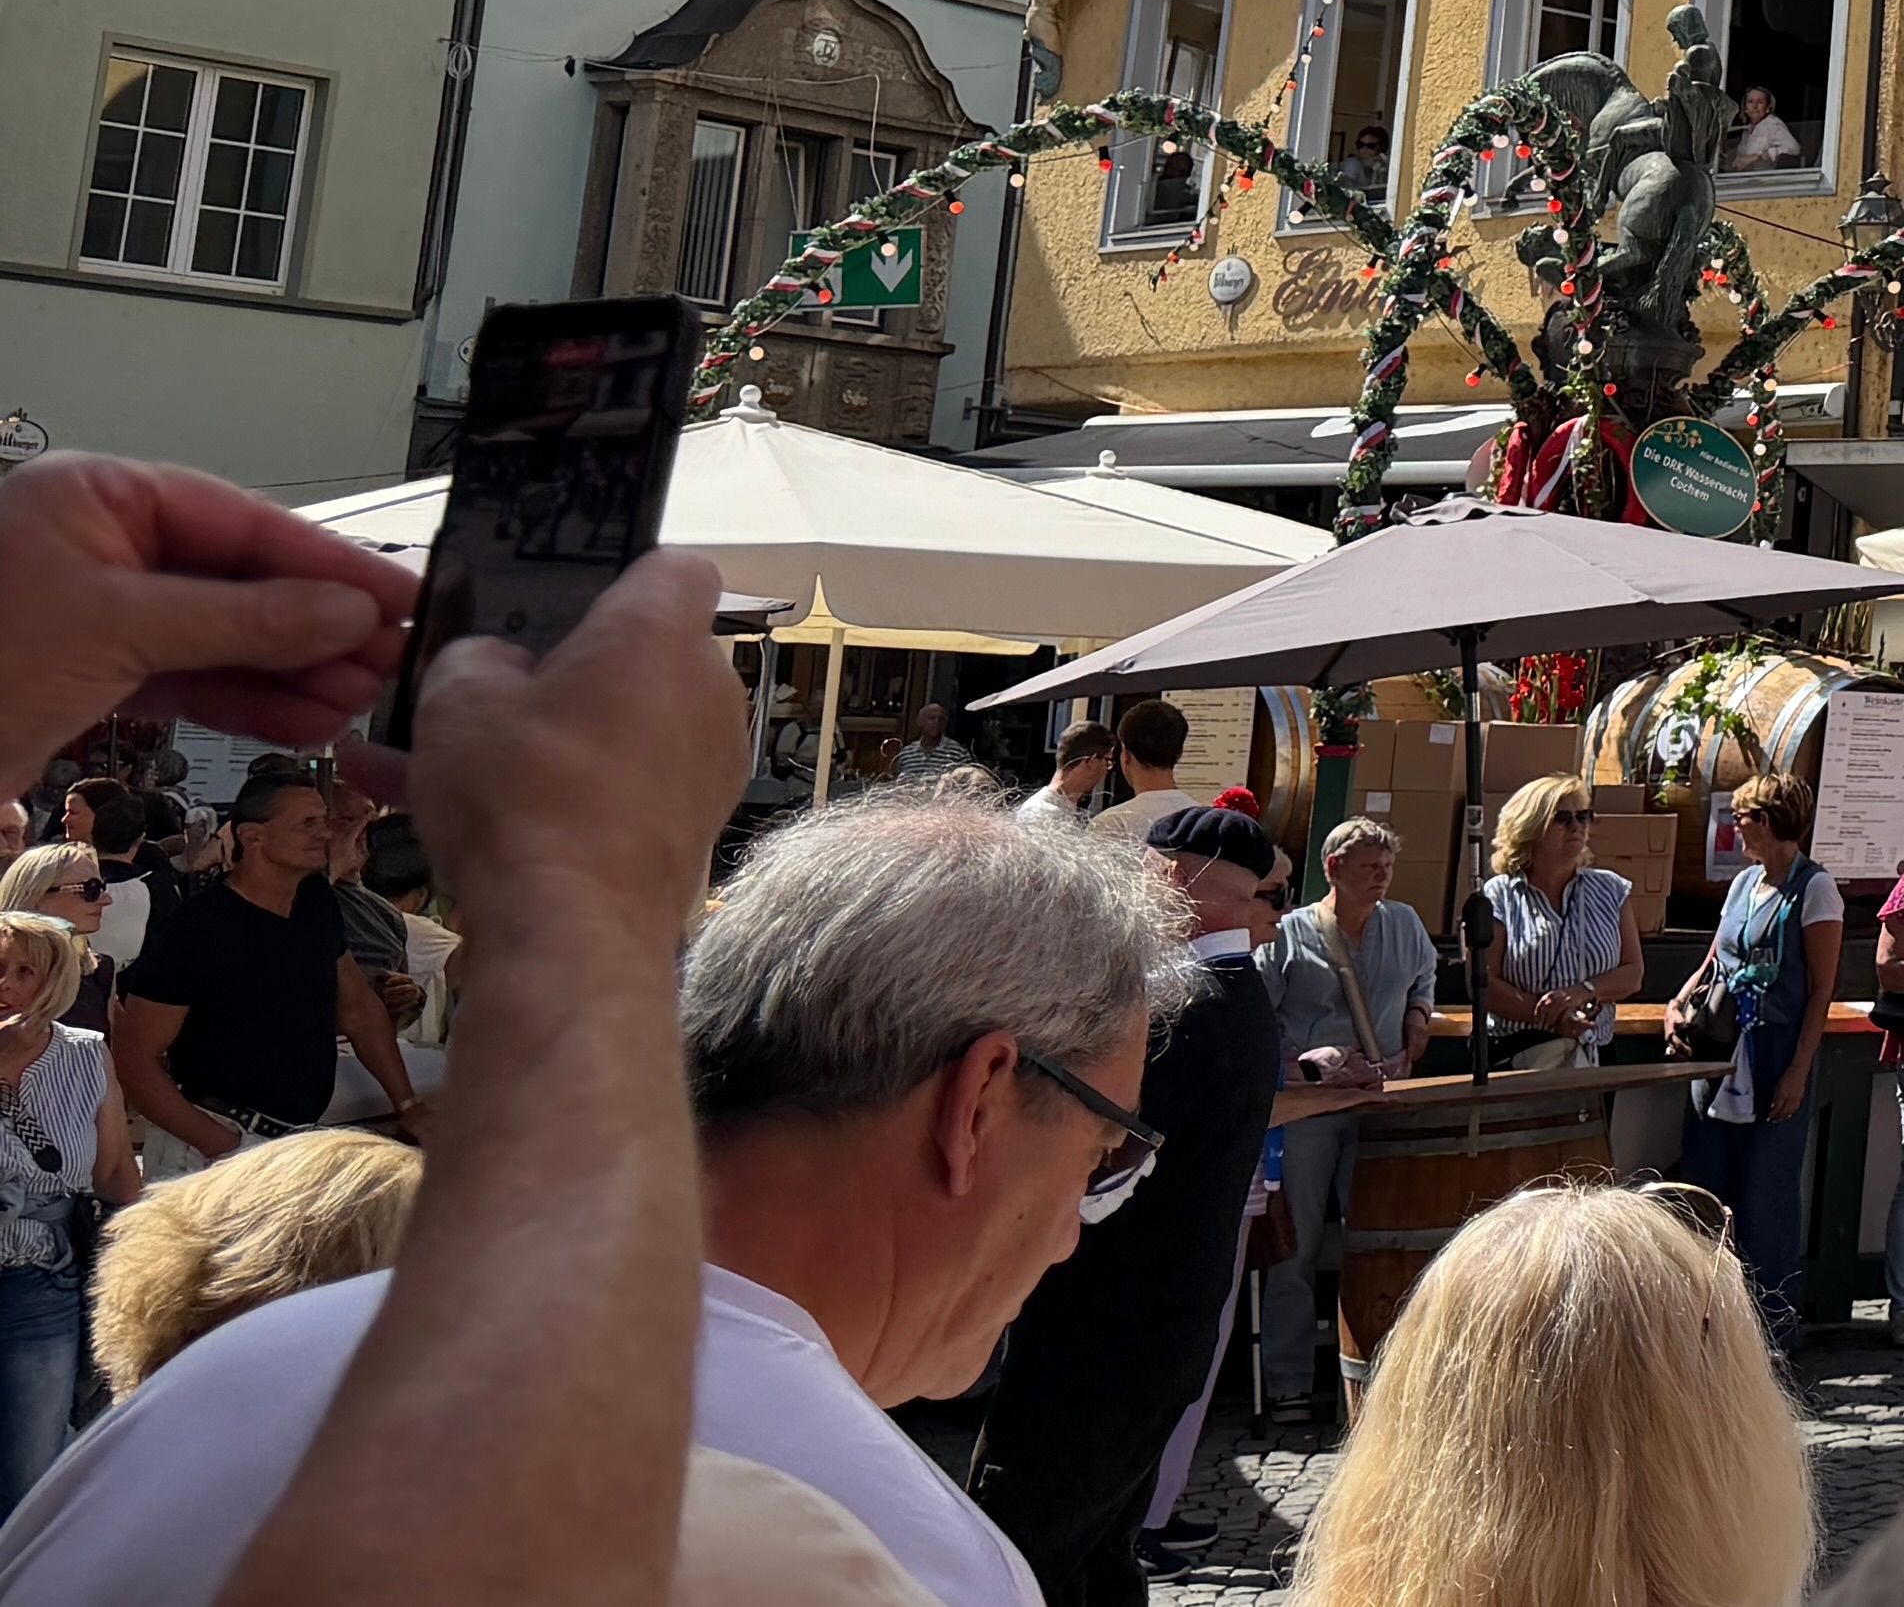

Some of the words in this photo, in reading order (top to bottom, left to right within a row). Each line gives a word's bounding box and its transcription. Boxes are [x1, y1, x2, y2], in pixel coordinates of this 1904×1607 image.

[1643, 446, 1662, 464] Die
[1662, 455, 1685, 474] DRK
[1684, 465, 1749, 503] Wasserwacht
[1670, 475, 1710, 502] Cochem
